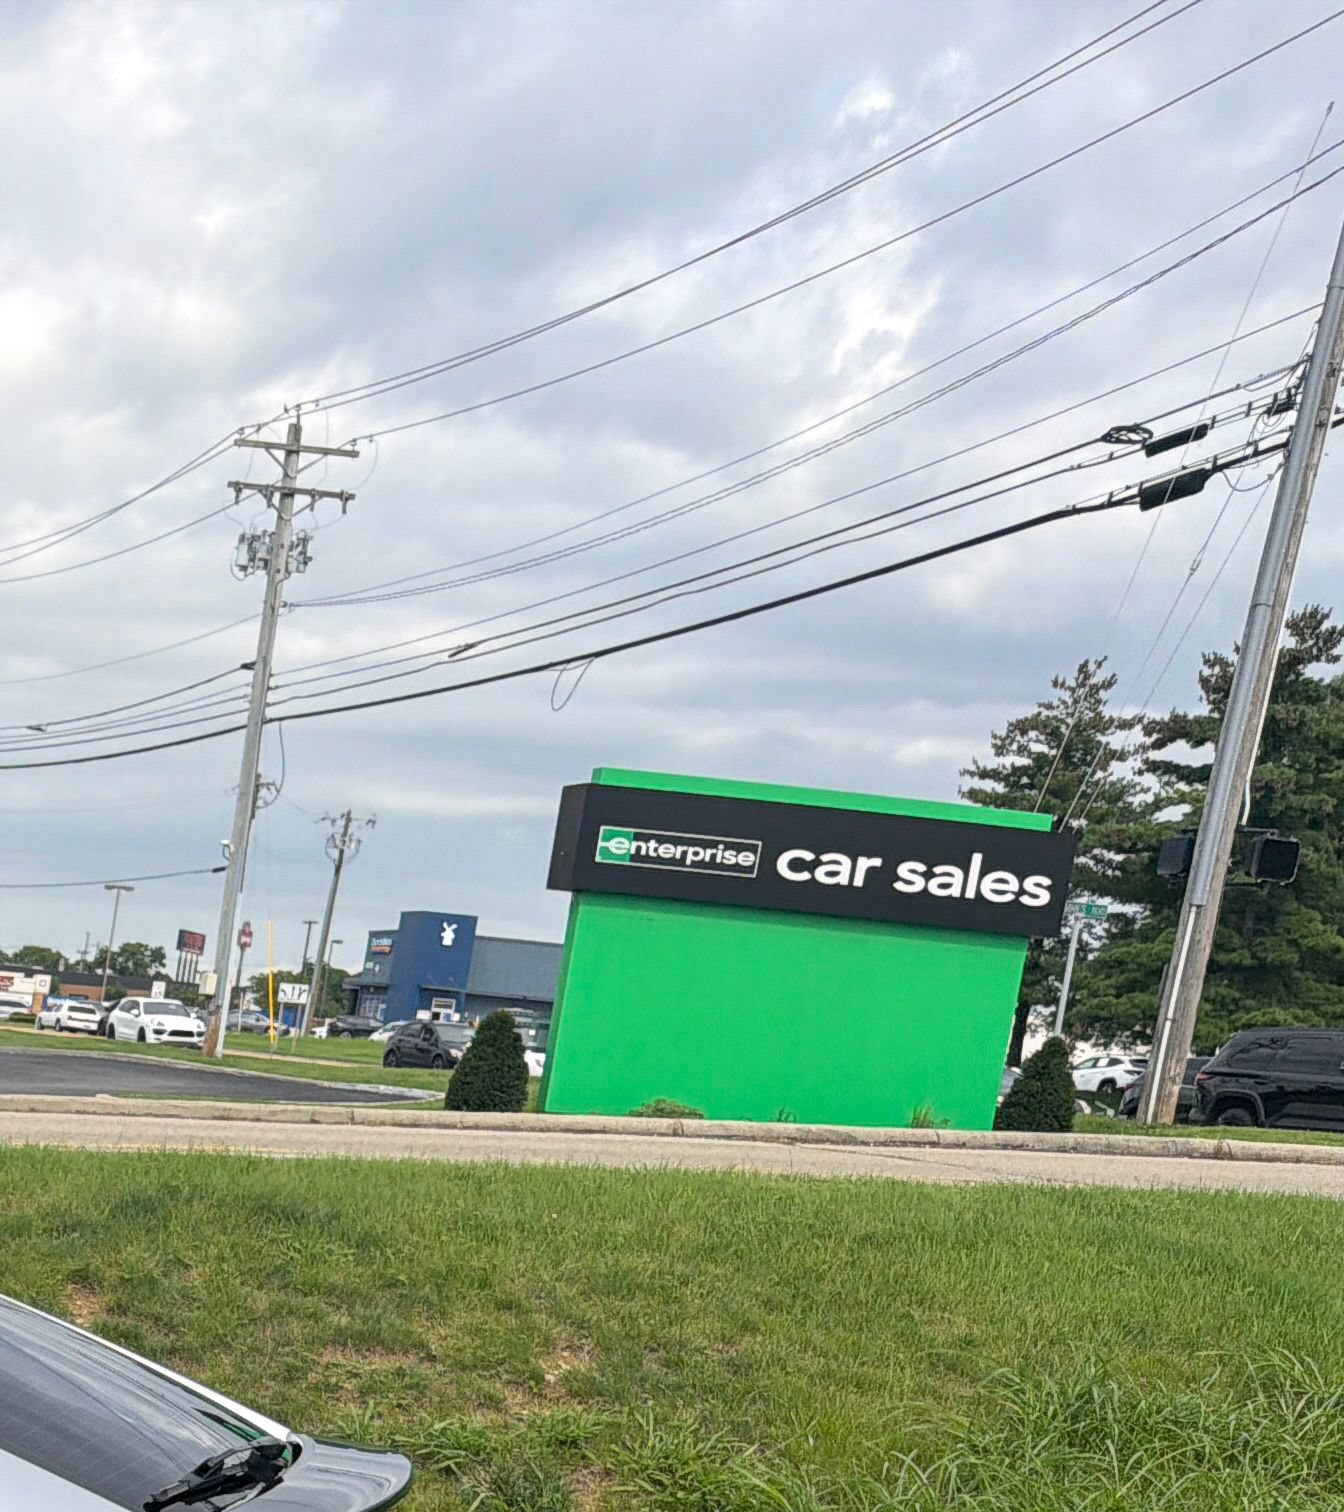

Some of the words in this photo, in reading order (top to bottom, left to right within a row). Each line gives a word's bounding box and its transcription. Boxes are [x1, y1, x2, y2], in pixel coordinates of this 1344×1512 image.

[607, 837, 756, 867] enterprise
[776, 849, 883, 888] car
[891, 852, 1053, 907] sales
